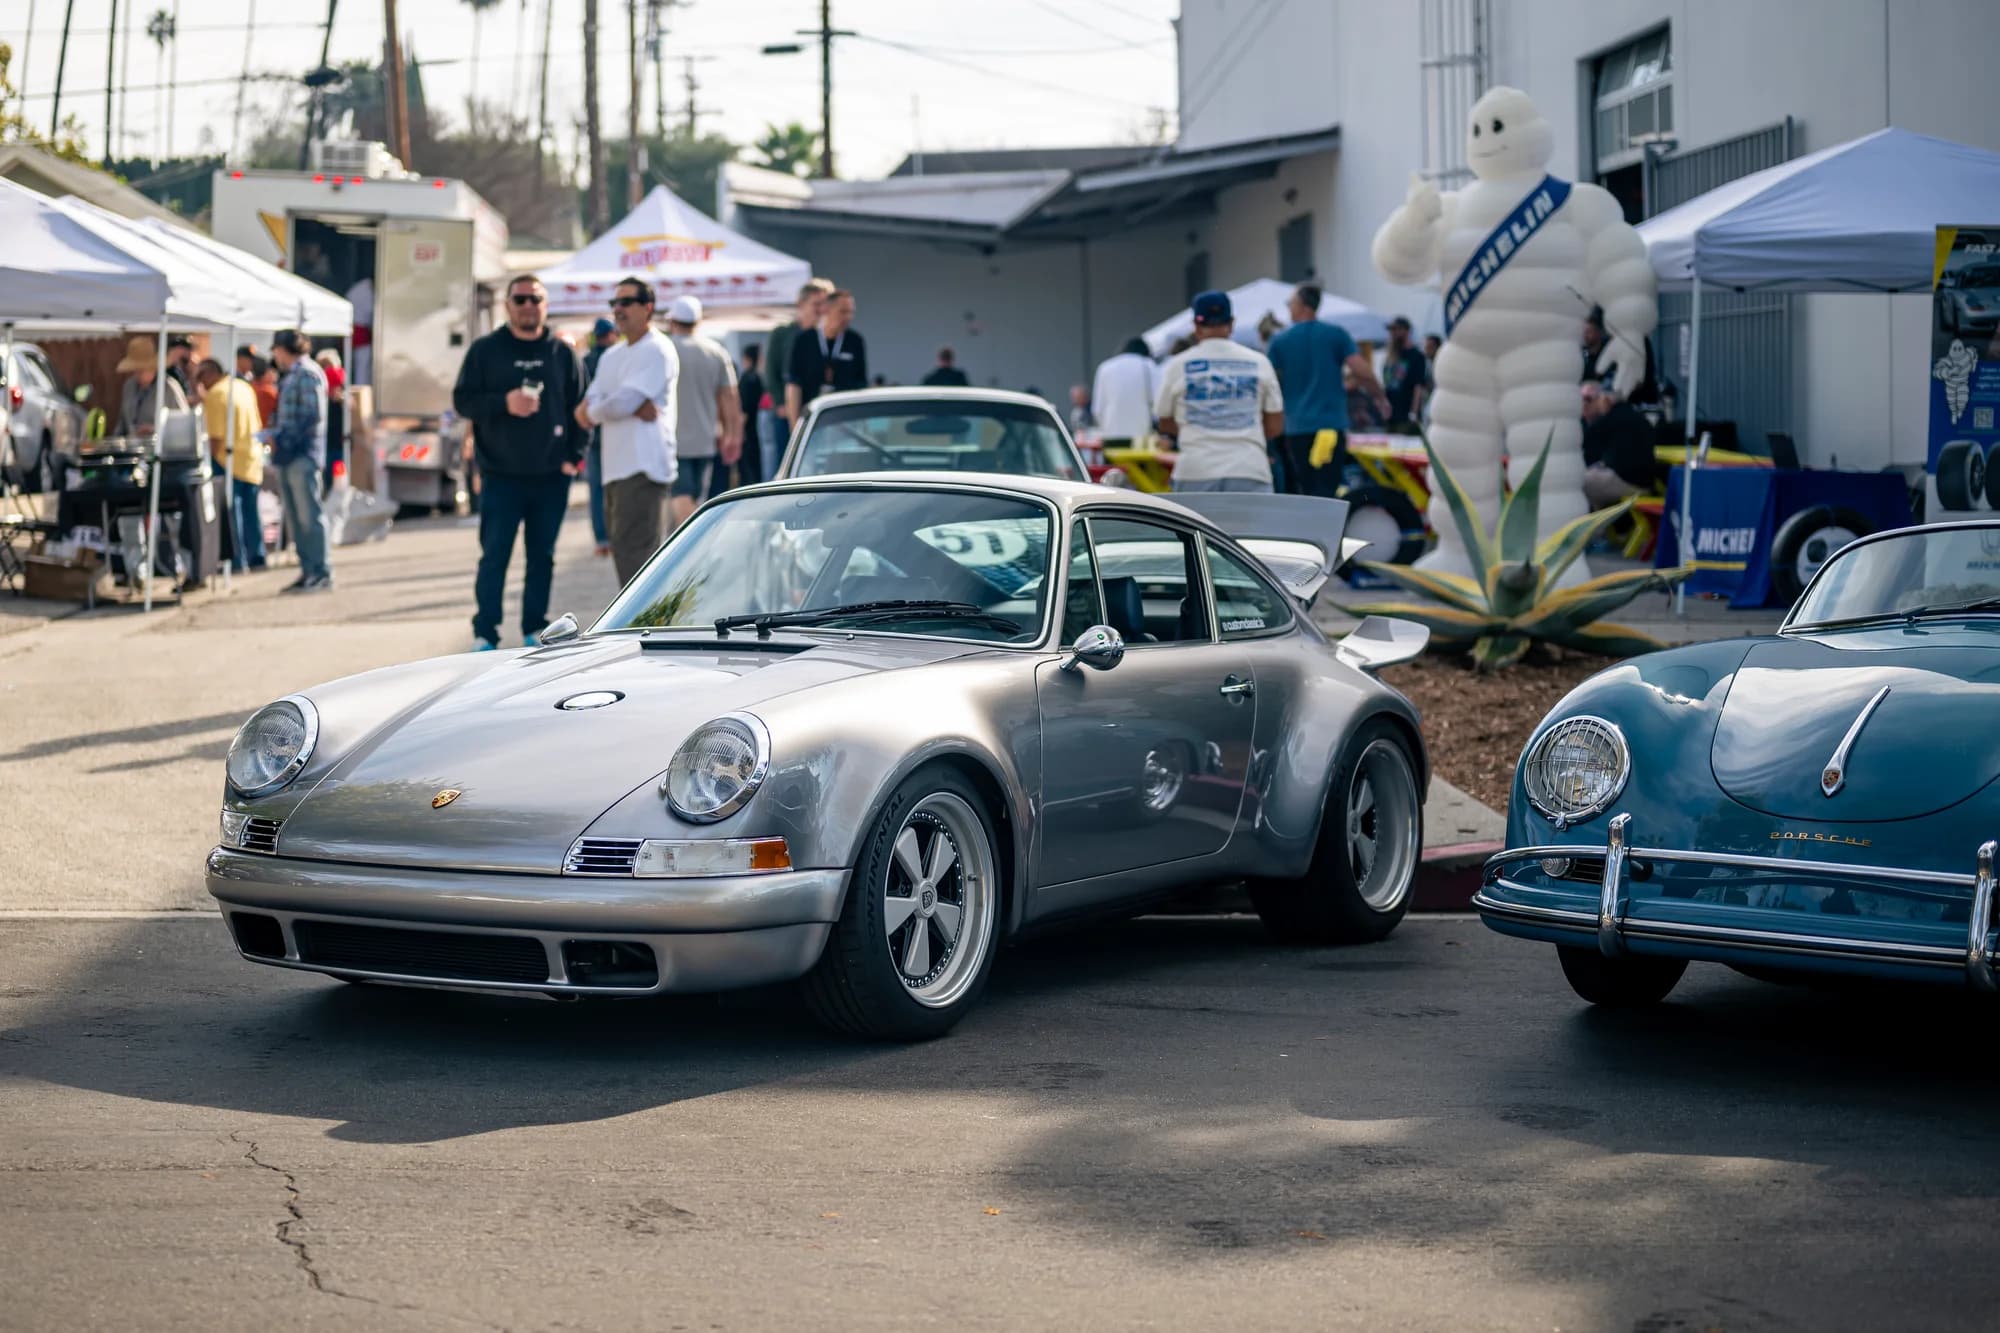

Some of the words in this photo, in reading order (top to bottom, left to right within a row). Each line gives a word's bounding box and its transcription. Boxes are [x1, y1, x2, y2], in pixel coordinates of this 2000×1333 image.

[1448, 189, 1555, 323] MICHELIN
[1964, 243, 1997, 254] FAST
[1768, 831, 1873, 847] PORSCHE
